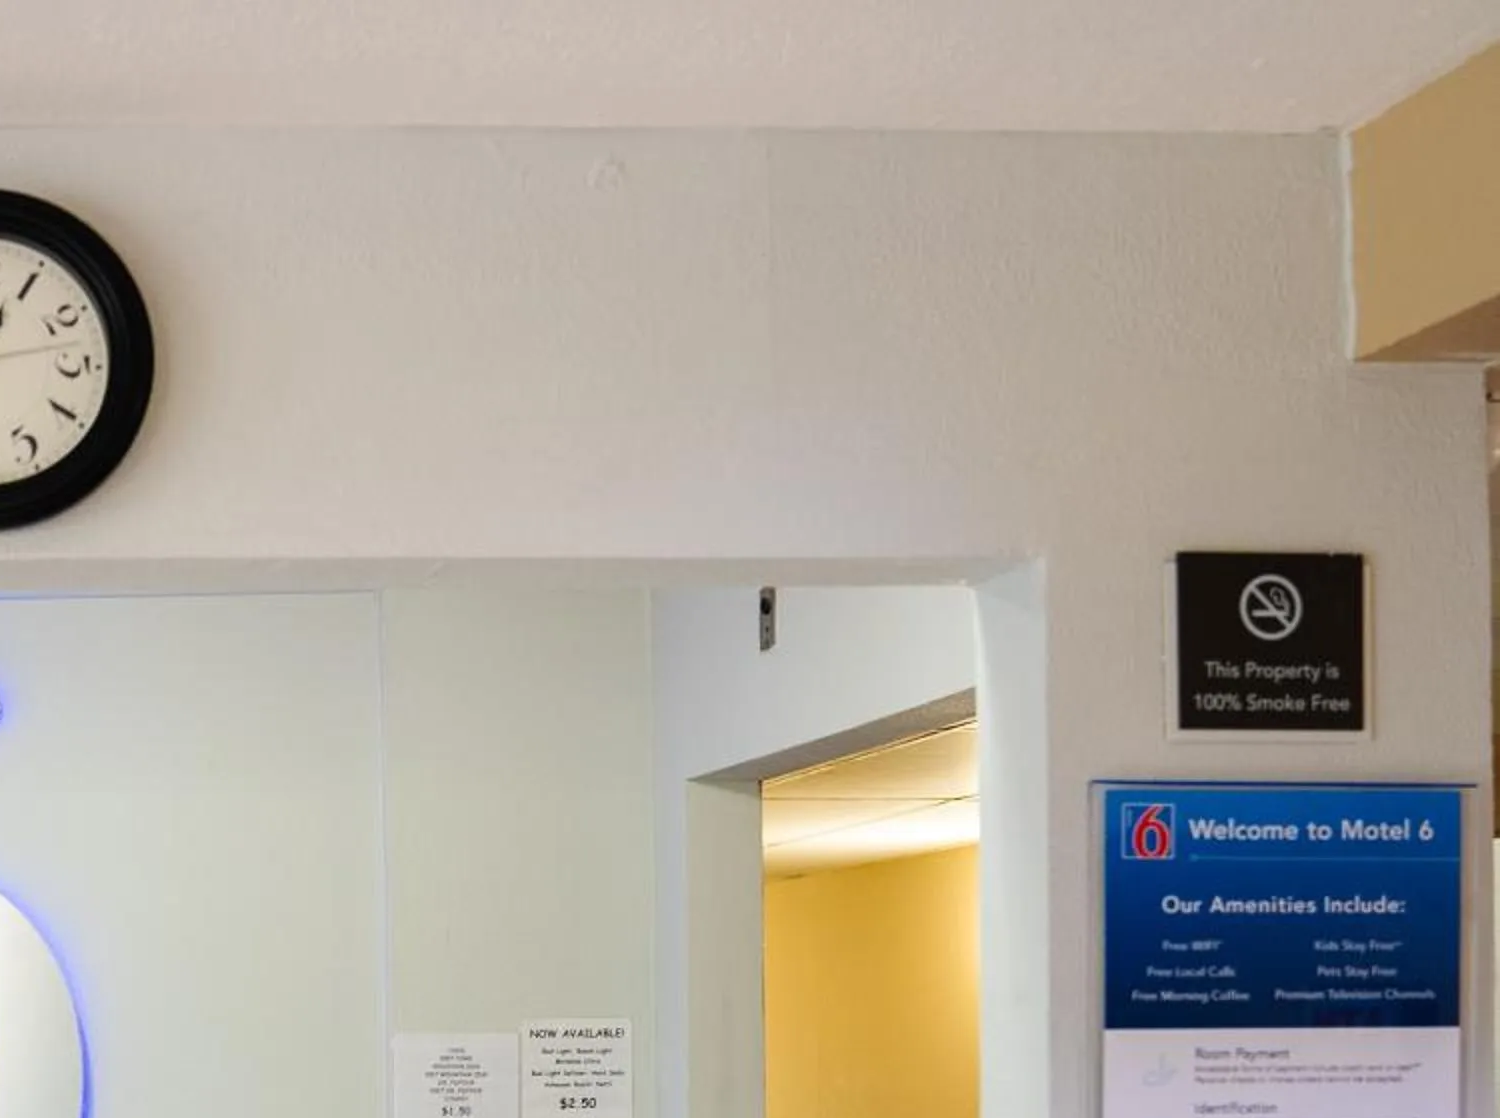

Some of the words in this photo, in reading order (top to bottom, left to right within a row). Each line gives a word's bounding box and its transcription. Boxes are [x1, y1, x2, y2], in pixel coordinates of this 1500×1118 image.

[18, 272, 39, 300] 1
[41, 304, 79, 336] 2
[55, 353, 91, 379] 3
[11, 424, 39, 464] 5
[1204, 661, 1240, 679] This
[1245, 661, 1321, 684] Property
[1325, 662, 1340, 679] is
[1194, 693, 1242, 711] 100%
[1246, 694, 1305, 711] Smoke
[1311, 694, 1350, 711] Free
[1132, 804, 1171, 860] 6
[1188, 819, 1298, 841] Welcome
[1308, 821, 1332, 841] to
[1341, 819, 1410, 841] Motel
[1418, 819, 1434, 841] 6
[1161, 895, 1201, 914] Our
[1209, 896, 1317, 914] Amenities
[1324, 896, 1406, 914] Include:
[1162, 940, 1188, 951] Free
[1314, 940, 1339, 951] Kids
[1342, 940, 1366, 953] Stay
[1146, 966, 1173, 977] Free
[1175, 966, 1206, 977] Local
[1209, 966, 1236, 977] Calls
[1317, 966, 1341, 976] Pets
[1345, 966, 1369, 979] Stay
[1372, 966, 1398, 976] Free
[1132, 990, 1158, 1001] Free
[1160, 990, 1208, 1004] Morning
[1212, 990, 1250, 1001] Coffee
[1275, 989, 1325, 1000] Premium
[1328, 989, 1382, 1000] Television
[1385, 989, 1436, 1000] Channels
[529, 1028, 557, 1039] NOW
[562, 1027, 625, 1038] AVAILABLE!
[1194, 1048, 1231, 1060] Room
[1236, 1047, 1290, 1064] Payment
[560, 1097, 597, 1110] $2.50
[1194, 1101, 1278, 1114] Identification
